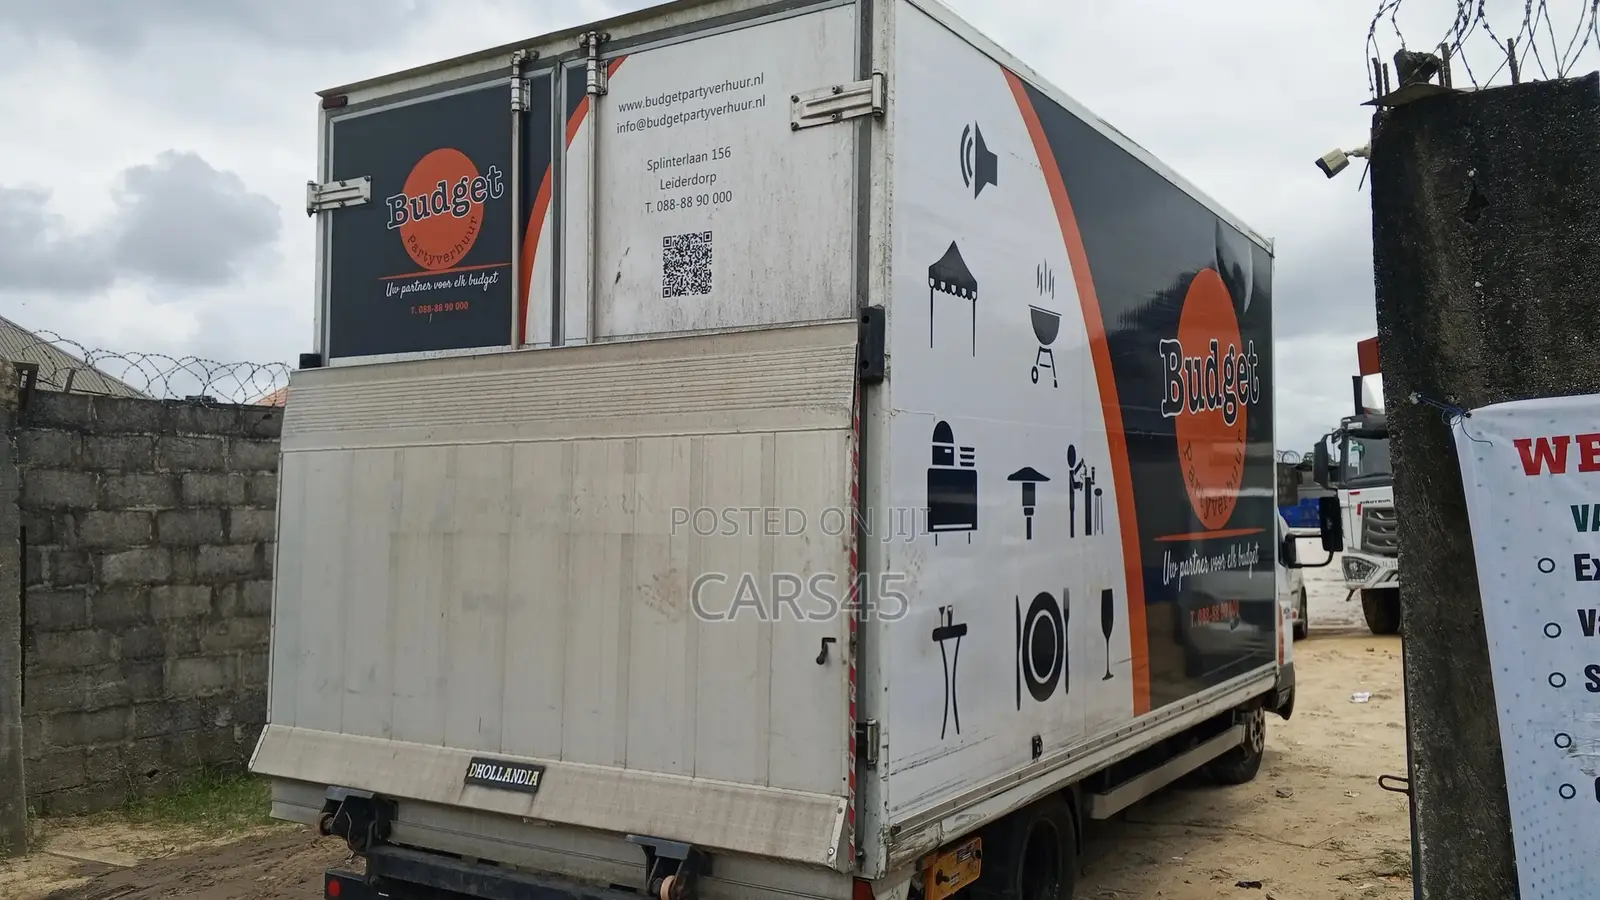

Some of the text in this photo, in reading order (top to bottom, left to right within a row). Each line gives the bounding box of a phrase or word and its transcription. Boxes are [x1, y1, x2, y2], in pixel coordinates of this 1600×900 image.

[618, 72, 764, 113] www.budgetpartyverhuur.nl
[616, 95, 766, 134] info@budgetpartyverhuur.nl
[646, 146, 732, 173] Splinterlaan 156
[386, 165, 504, 230] Budget
[659, 173, 717, 190] Leiderdorp
[645, 190, 733, 214] T. 088-88 90 000
[407, 216, 478, 266] Partyverhuur
[386, 271, 500, 299] Uw partner voor elk budget
[419, 303, 443, 314] 088-88
[444, 303, 454, 312] 90
[455, 301, 469, 310] 000
[1159, 338, 1260, 427] Budget
[1163, 549, 1180, 586] Uw
[1178, 548, 1209, 592] partner
[1238, 541, 1260, 579] budget
[468, 763, 540, 786] DHOLLANDIA
